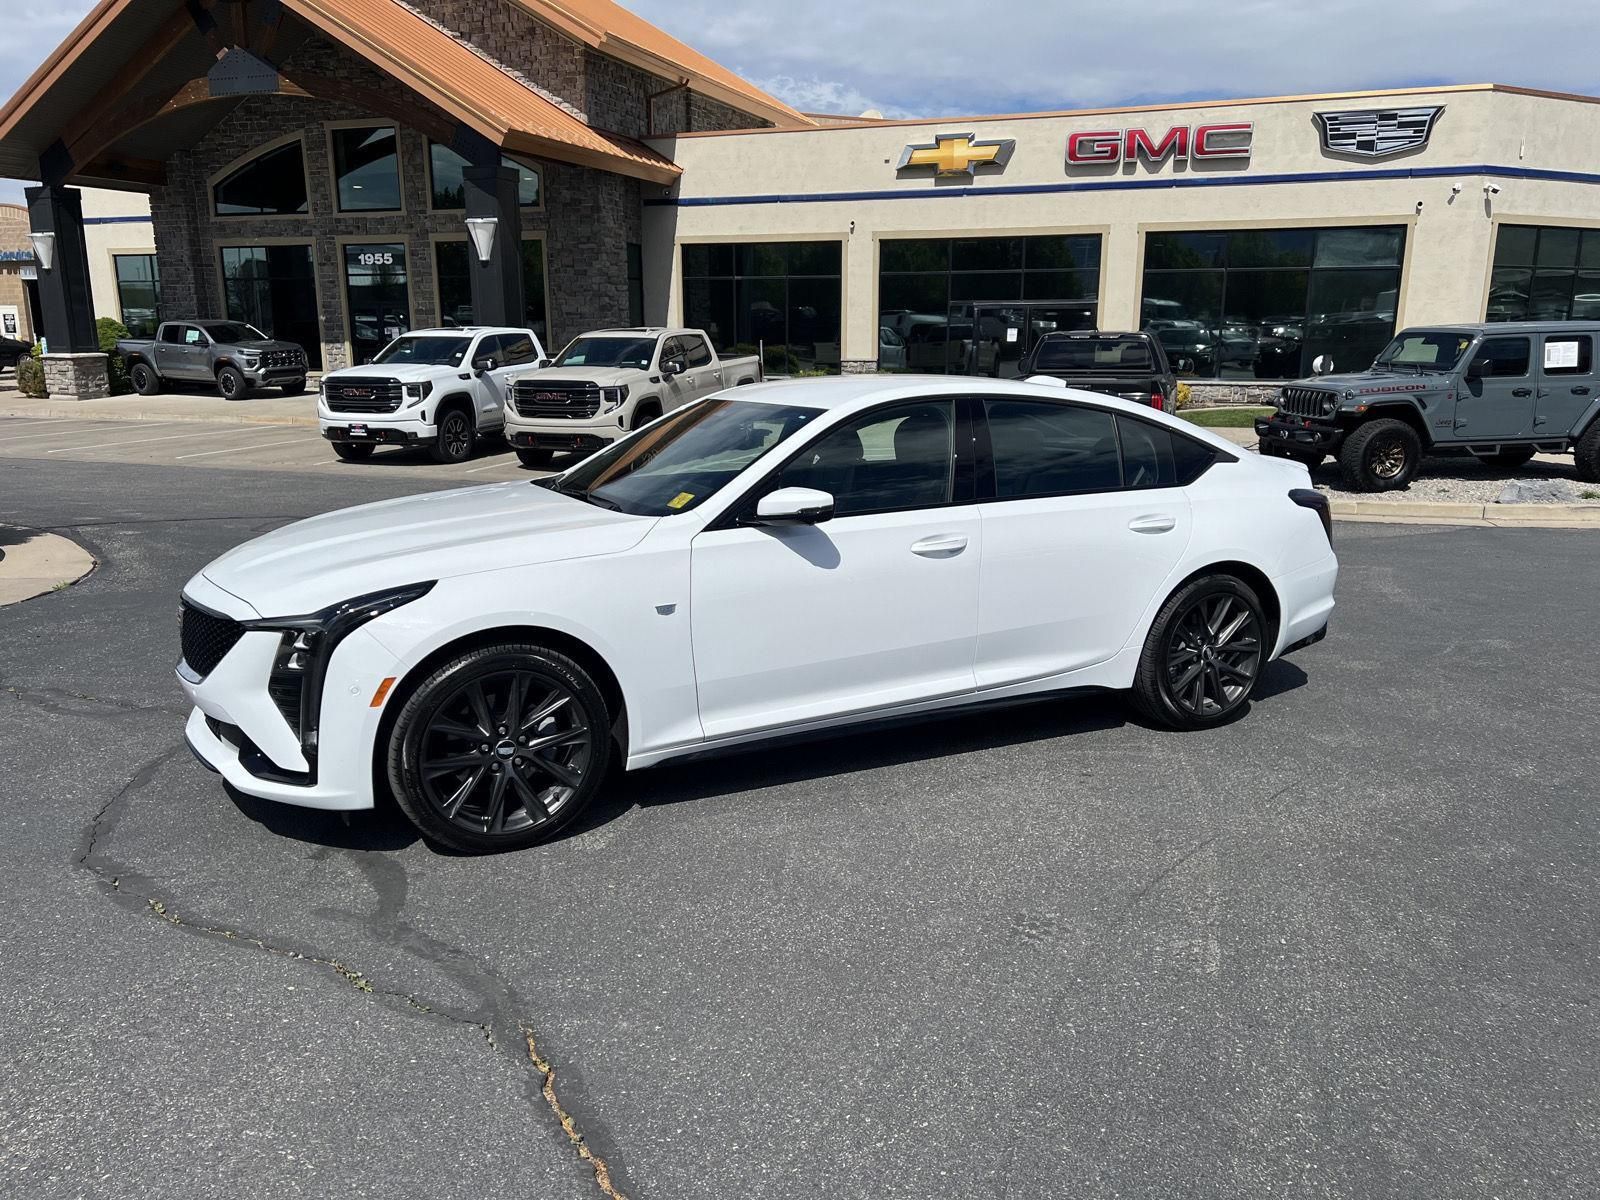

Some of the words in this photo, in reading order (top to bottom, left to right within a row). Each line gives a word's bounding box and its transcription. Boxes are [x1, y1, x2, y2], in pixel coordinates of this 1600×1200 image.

[1065, 121, 1254, 164] GMC
[358, 252, 393, 265] 1955
[1360, 384, 1426, 393] RUBICON
[534, 392, 568, 401] GMC
